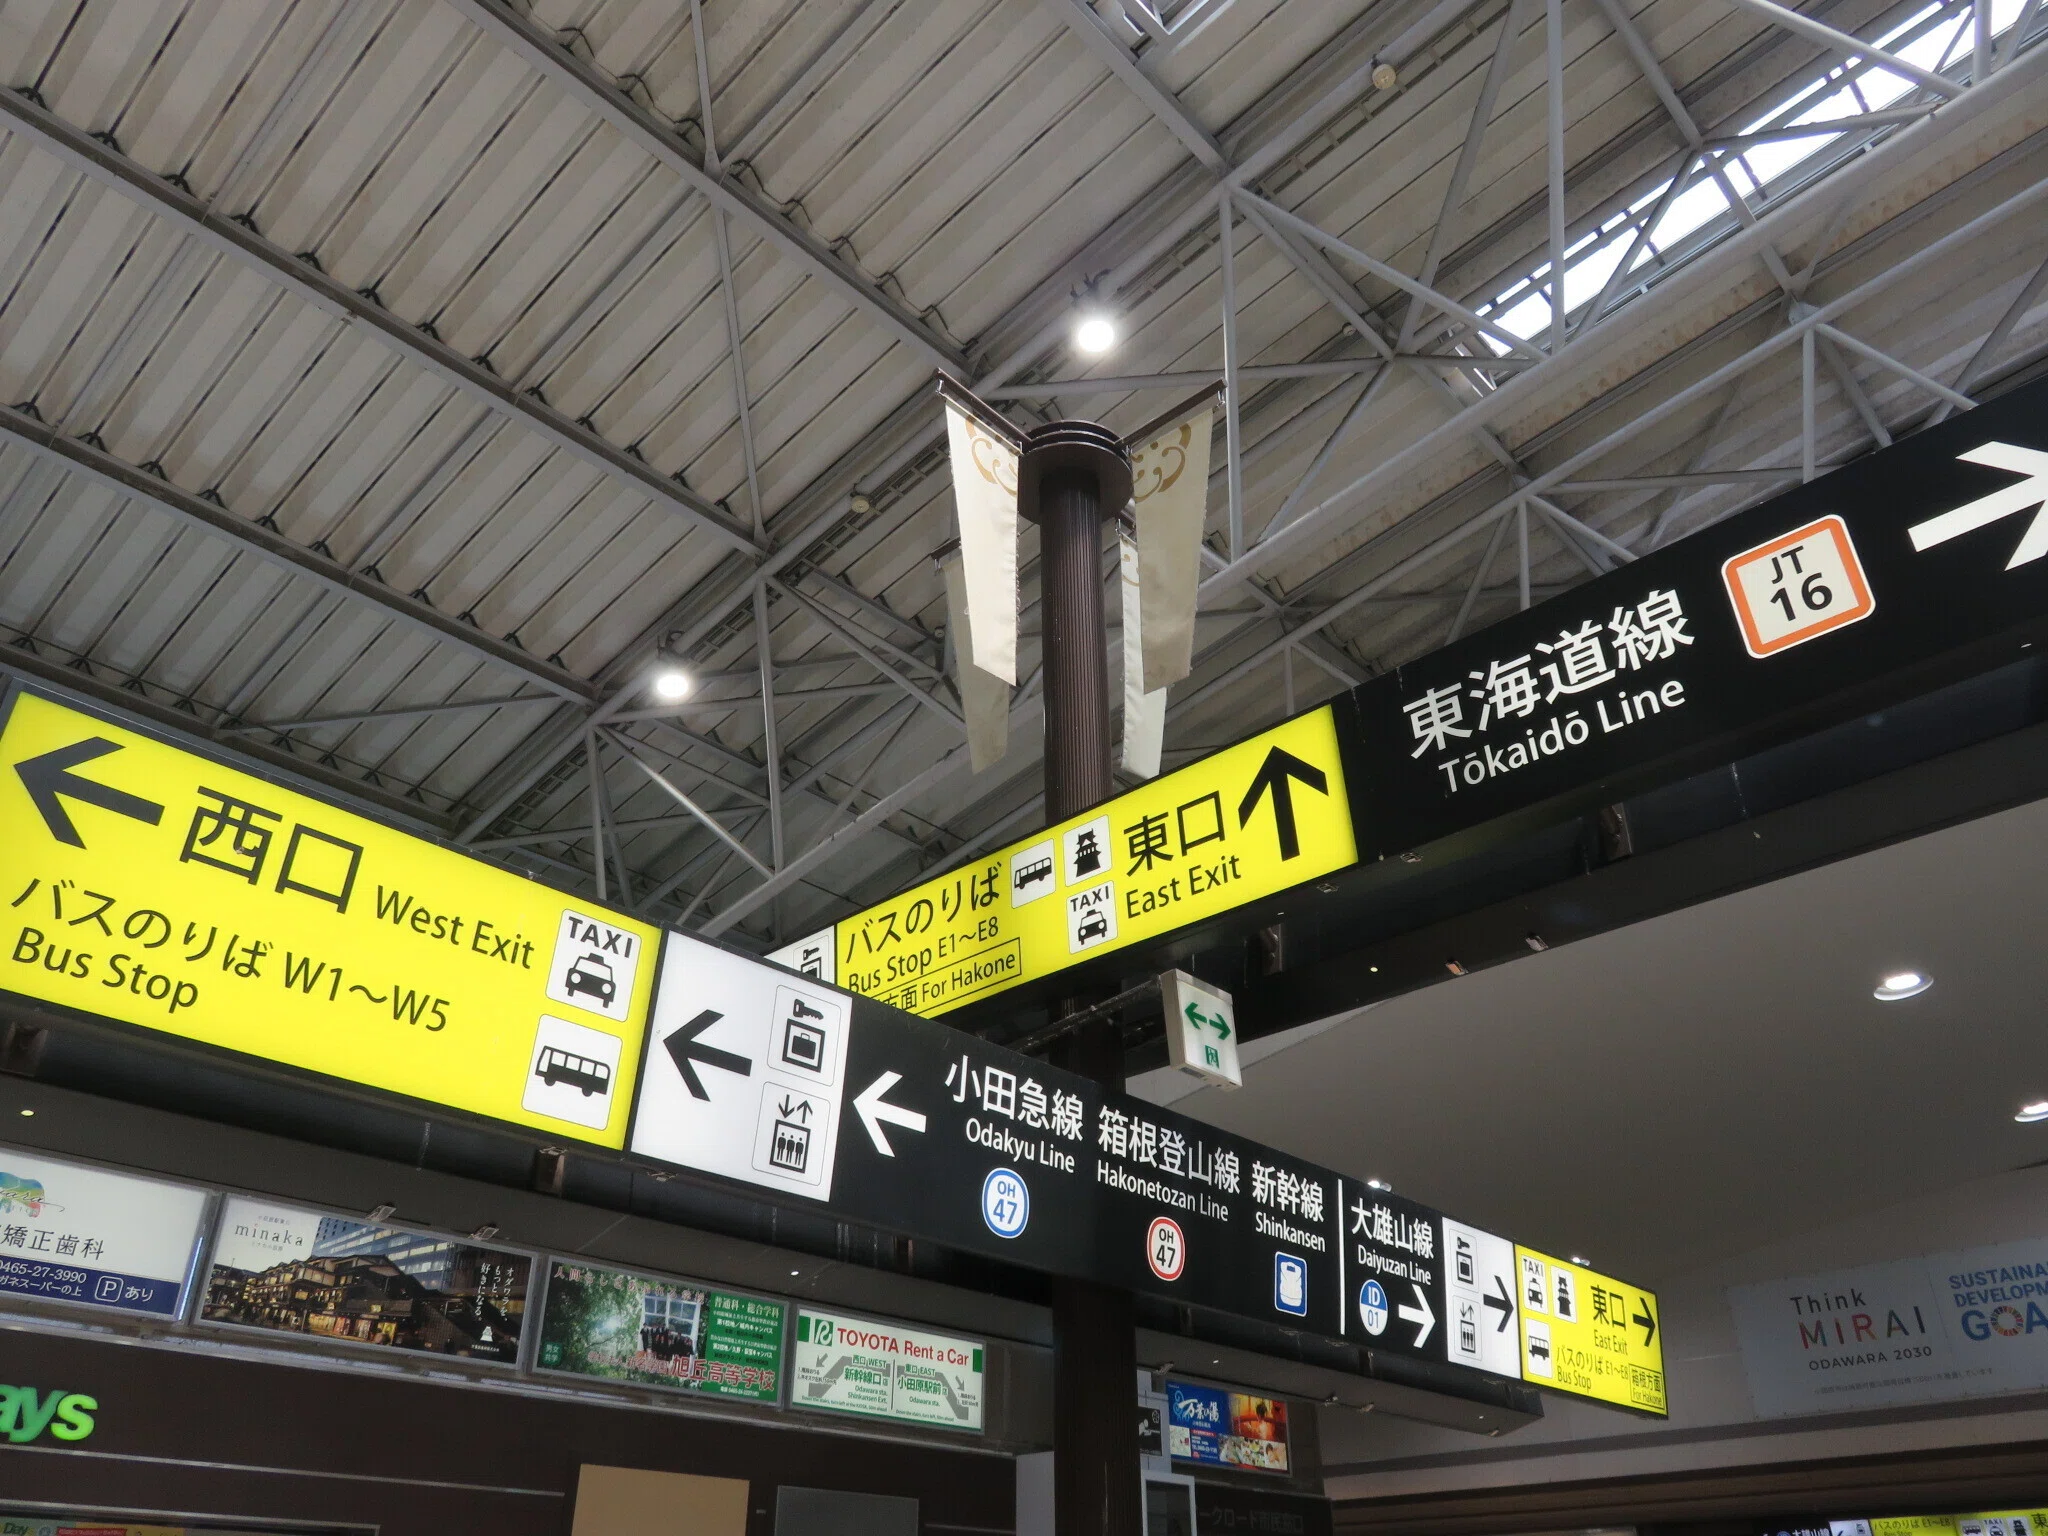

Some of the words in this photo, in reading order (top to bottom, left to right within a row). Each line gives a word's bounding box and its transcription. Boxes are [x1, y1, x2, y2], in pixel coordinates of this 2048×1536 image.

[1771, 546, 1805, 584] JT
[1770, 573, 1834, 622] 16
[1403, 589, 1694, 759] 東海道線
[1439, 709, 1590, 793] Tōkaidō
[1597, 677, 1686, 733] Line
[180, 786, 364, 914] 西口
[1123, 791, 1227, 877] 東口
[1070, 887, 1110, 912] TAXI
[1127, 880, 1182, 920] East
[1191, 854, 1242, 894] Exit
[11, 878, 274, 979] バスのりば
[375, 885, 468, 949] West
[471, 920, 535, 969] Exit
[845, 860, 1003, 964] バスのりば
[568, 915, 633, 959] TAXI
[12, 927, 92, 978] Bus
[102, 953, 198, 1013] Stop
[849, 962, 882, 993] Bus
[887, 942, 932, 980] Stop
[922, 975, 947, 1003] For
[952, 951, 1017, 994] Hakone
[944, 1054, 1085, 1142] 小田急線
[966, 1117, 1035, 1162] Odakyu
[1039, 1143, 1075, 1174] Line
[1098, 1104, 1241, 1196] 箱根登山線
[996, 1180, 1017, 1198] OH
[1098, 1160, 1196, 1213] Hakonetozan
[1200, 1195, 1229, 1223] Line
[1251, 1160, 1325, 1224] 新幹線
[992, 1198, 1018, 1226] 47
[1350, 1197, 1434, 1261] 大雄山線
[0, 1223, 105, 1261] 矯正歯科
[234, 1222, 304, 1247] minaka
[1158, 1227, 1175, 1246] OH
[1255, 1212, 1326, 1252] Shinkansen
[1156, 1245, 1177, 1269] 47
[1358, 1245, 1408, 1282] Daiyuzan
[1409, 1261, 1432, 1286] Line
[1523, 1257, 1544, 1278] TAXI
[1948, 1261, 2048, 1290] SUSTAINA
[125, 1285, 154, 1303] あり
[1367, 1289, 1381, 1307] ID
[1590, 1284, 1628, 1333] 東口
[1790, 1288, 1867, 1316] Think
[1367, 1309, 1381, 1329] 01
[1797, 1305, 1927, 1351] MIRAI
[837, 1328, 899, 1354] TOYOTA
[904, 1340, 933, 1360] Rent
[936, 1350, 944, 1362] a
[947, 1349, 969, 1366] Car
[852, 1354, 866, 1365] 西口
[867, 1358, 887, 1368] WEST
[1556, 1345, 1604, 1376] バスのりば
[1594, 1328, 1613, 1352] East
[1613, 1335, 1629, 1356] Exit
[1808, 1351, 1889, 1372] ODAWARA
[1893, 1345, 1933, 1362] 2030
[905, 1363, 918, 1374] 東口
[919, 1366, 936, 1376] EAST
[1557, 1365, 1572, 1385] Bus
[1573, 1369, 1592, 1394] Stop
[847, 1391, 878, 1402] Shinkansen
[854, 1385, 878, 1395] Odawara
[909, 1396, 932, 1406] Odawara
[1873, 1517, 1921, 1531] バスのりば
